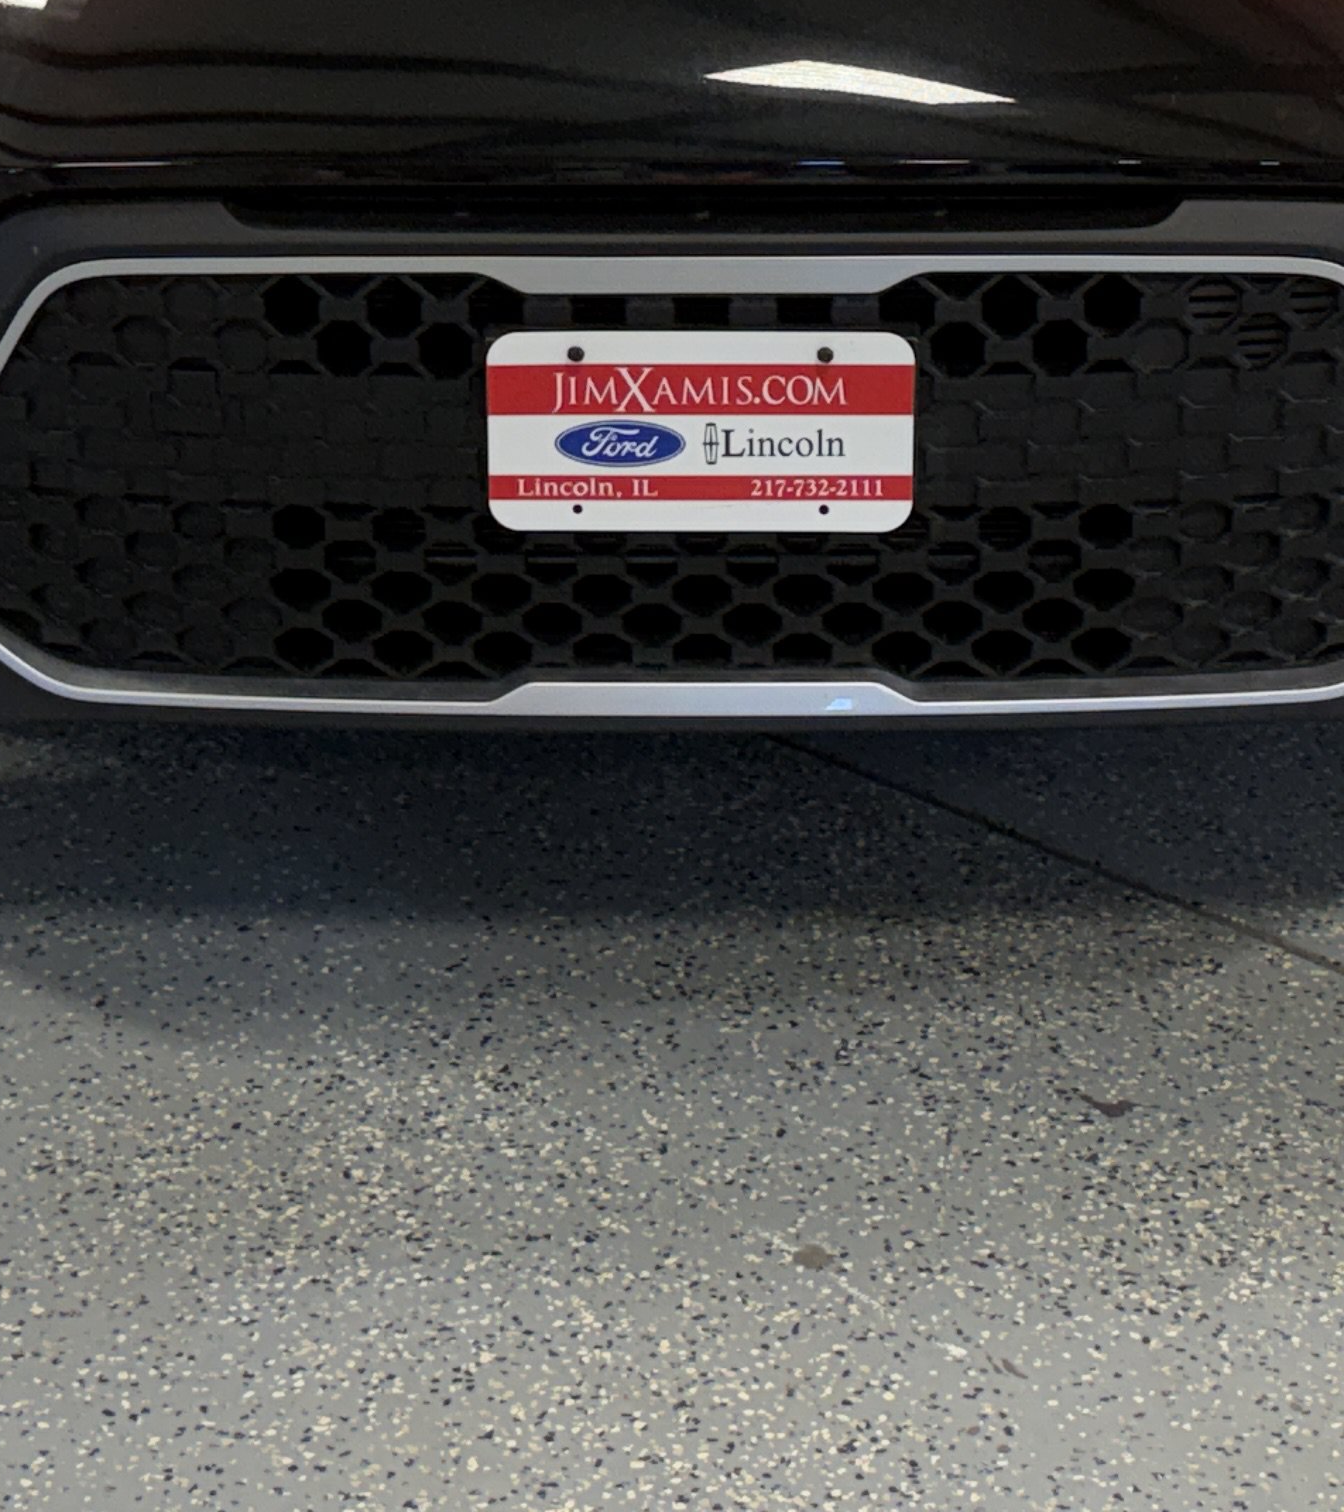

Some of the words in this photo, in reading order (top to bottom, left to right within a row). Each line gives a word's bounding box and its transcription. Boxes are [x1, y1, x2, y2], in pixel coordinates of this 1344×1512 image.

[581, 426, 659, 457] Ford
[721, 428, 846, 458] Lincoln
[517, 477, 623, 498] Lincoln,
[632, 478, 659, 497] IL
[750, 478, 884, 498] 217-732-2111
